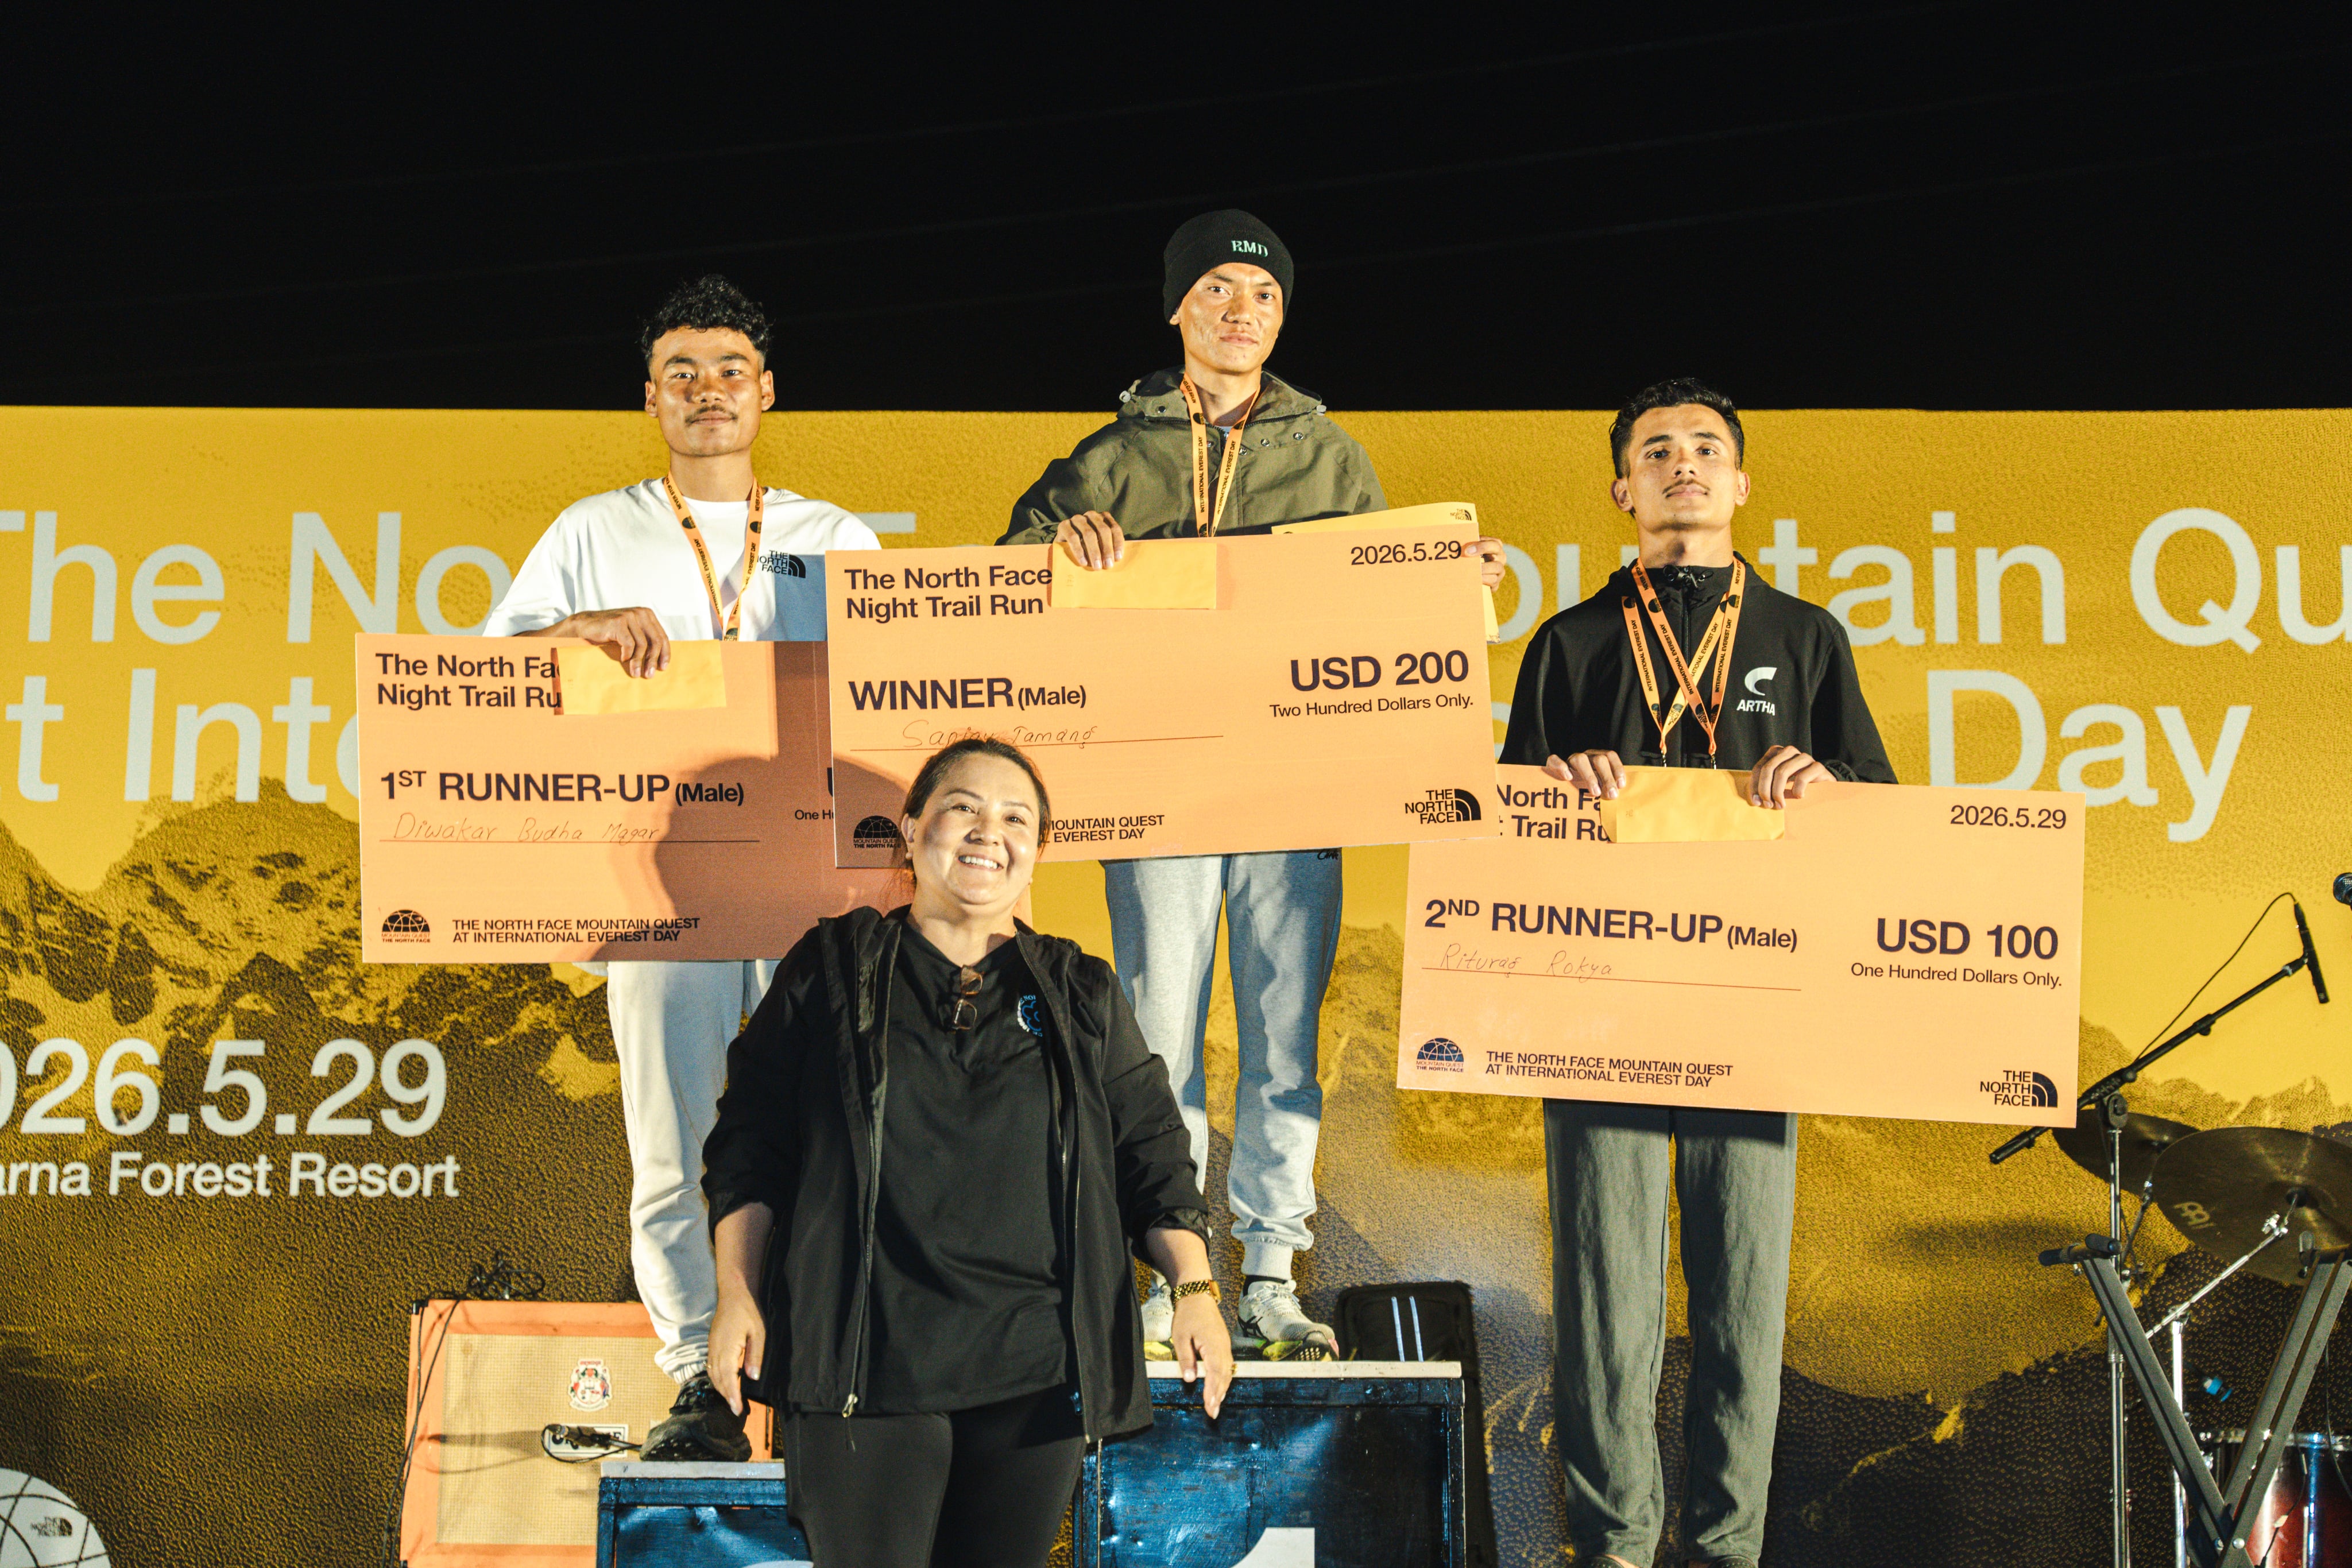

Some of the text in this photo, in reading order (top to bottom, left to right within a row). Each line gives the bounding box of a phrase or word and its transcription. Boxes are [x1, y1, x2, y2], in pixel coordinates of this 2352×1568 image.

[1225, 451, 1235, 474] EVEREST
[748, 552, 756, 575] EVEREST
[757, 555, 788, 567] ORTH
[769, 549, 788, 560] THE
[1351, 540, 1462, 566] 2026.5.29
[761, 564, 788, 575] FACE
[844, 568, 895, 590] The
[904, 566, 980, 589] North
[989, 565, 1053, 586] Face
[847, 594, 1044, 624] Night Trail Run
[1633, 629, 1643, 652] EVEREST
[1659, 624, 1669, 634] DAY
[1664, 633, 1678, 656] EVEREST
[1700, 633, 1714, 656] EVEREST
[375, 653, 560, 679] The North Fa
[1290, 650, 1469, 692] USD 200
[1639, 652, 1654, 692] INTERNATIONAL
[1715, 653, 1726, 693] INTERNATIONAL
[1721, 629, 1731, 653] EVEREST
[1674, 656, 1694, 695] INTERNATIONAL
[378, 683, 452, 711] Night
[459, 686, 516, 707] Trail
[848, 677, 1087, 711] WINNER (Male)
[1269, 693, 1474, 718] Two Hundred Dollars Only.
[1736, 699, 1776, 717] ARTHA
[1926, 669, 2253, 843] Day
[381, 770, 744, 806] 1ST RUNNER-UP (Male)
[1425, 788, 1453, 801] THE
[794, 809, 819, 820] One
[1405, 800, 1454, 814] NORTH
[1420, 812, 1455, 824] FACE
[1950, 804, 2067, 830] 2026.5.29
[1051, 814, 1165, 831] OUNTAIN QUEST
[1511, 815, 1567, 839] Trail
[1054, 828, 1145, 843] EVEREST DAY
[452, 917, 700, 931] THE NORTH FACE MOUNTAIN QUEST
[1424, 899, 1798, 953] 2ND RUNNER-UP (Male)
[452, 930, 681, 943] AT INTERNATIONAL EVEREST DAY
[1877, 917, 2059, 961] USD 100
[1851, 962, 2063, 990] One Hundred Dollars Only.
[1485, 1064, 1713, 1087] AT INTERNATIONAL EVEREST DAY
[1486, 1051, 1734, 1077] THE NORTH FACE MOUNTAIN QUEST
[0, 1037, 447, 1137] 26.5.29
[2003, 1070, 2032, 1083] THE
[1980, 1082, 2032, 1095] NORTH
[1994, 1094, 2031, 1107] FACE
[0, 1151, 461, 1198] rna Forest Resort
